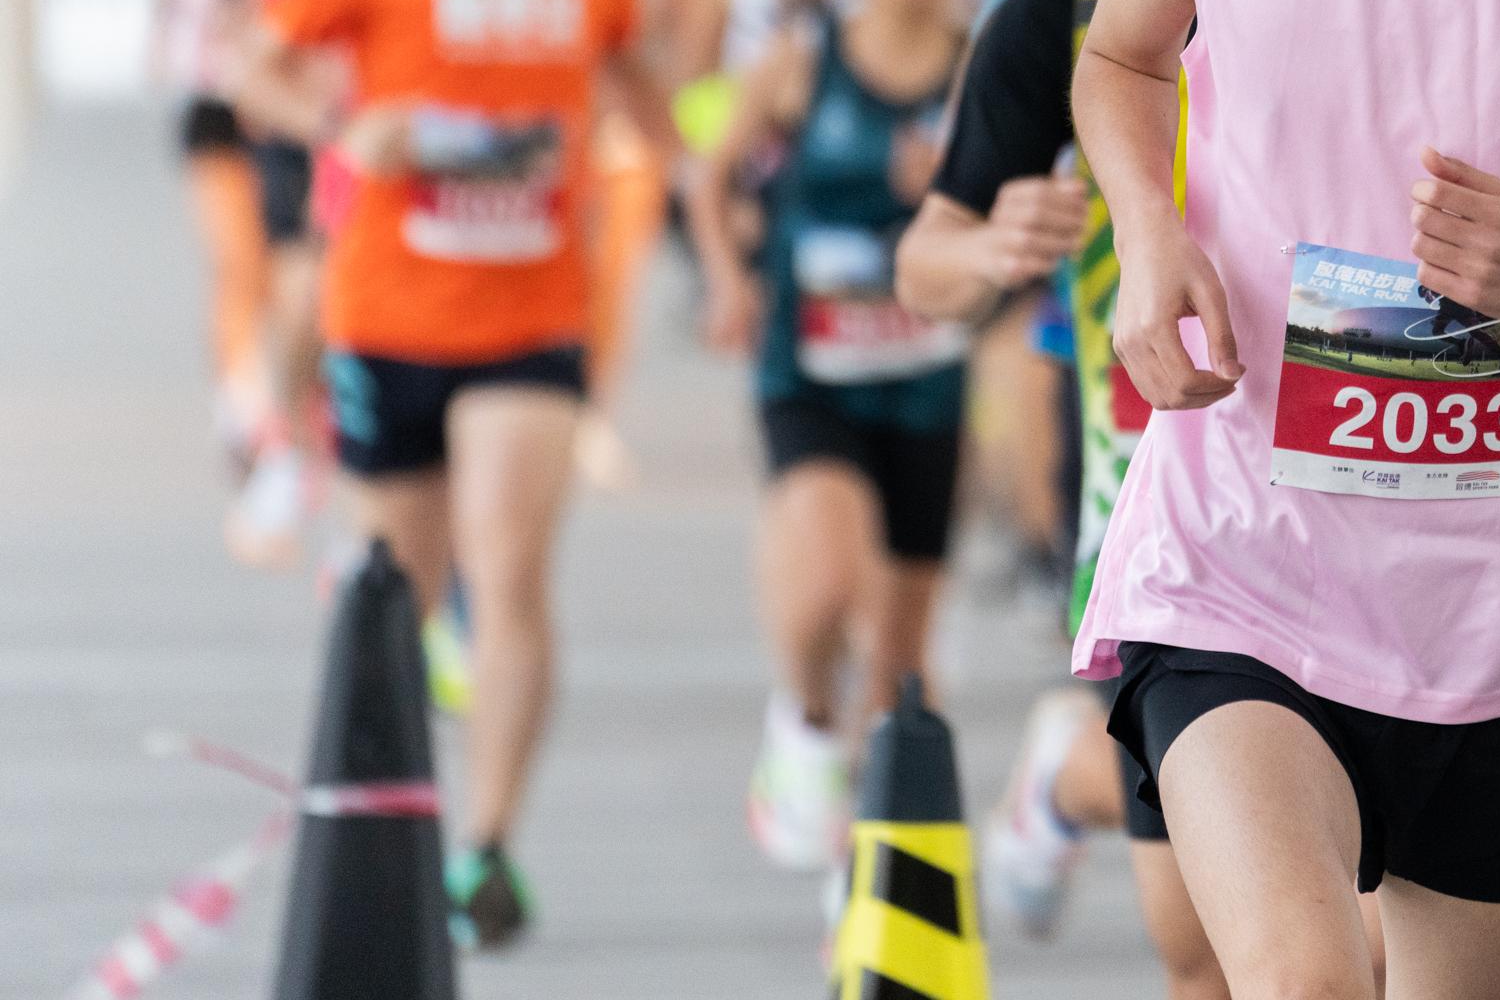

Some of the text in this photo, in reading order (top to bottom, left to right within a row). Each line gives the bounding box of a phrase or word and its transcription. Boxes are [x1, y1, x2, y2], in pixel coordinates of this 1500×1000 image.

[1309, 277, 1409, 302] KAI TAK RUN
